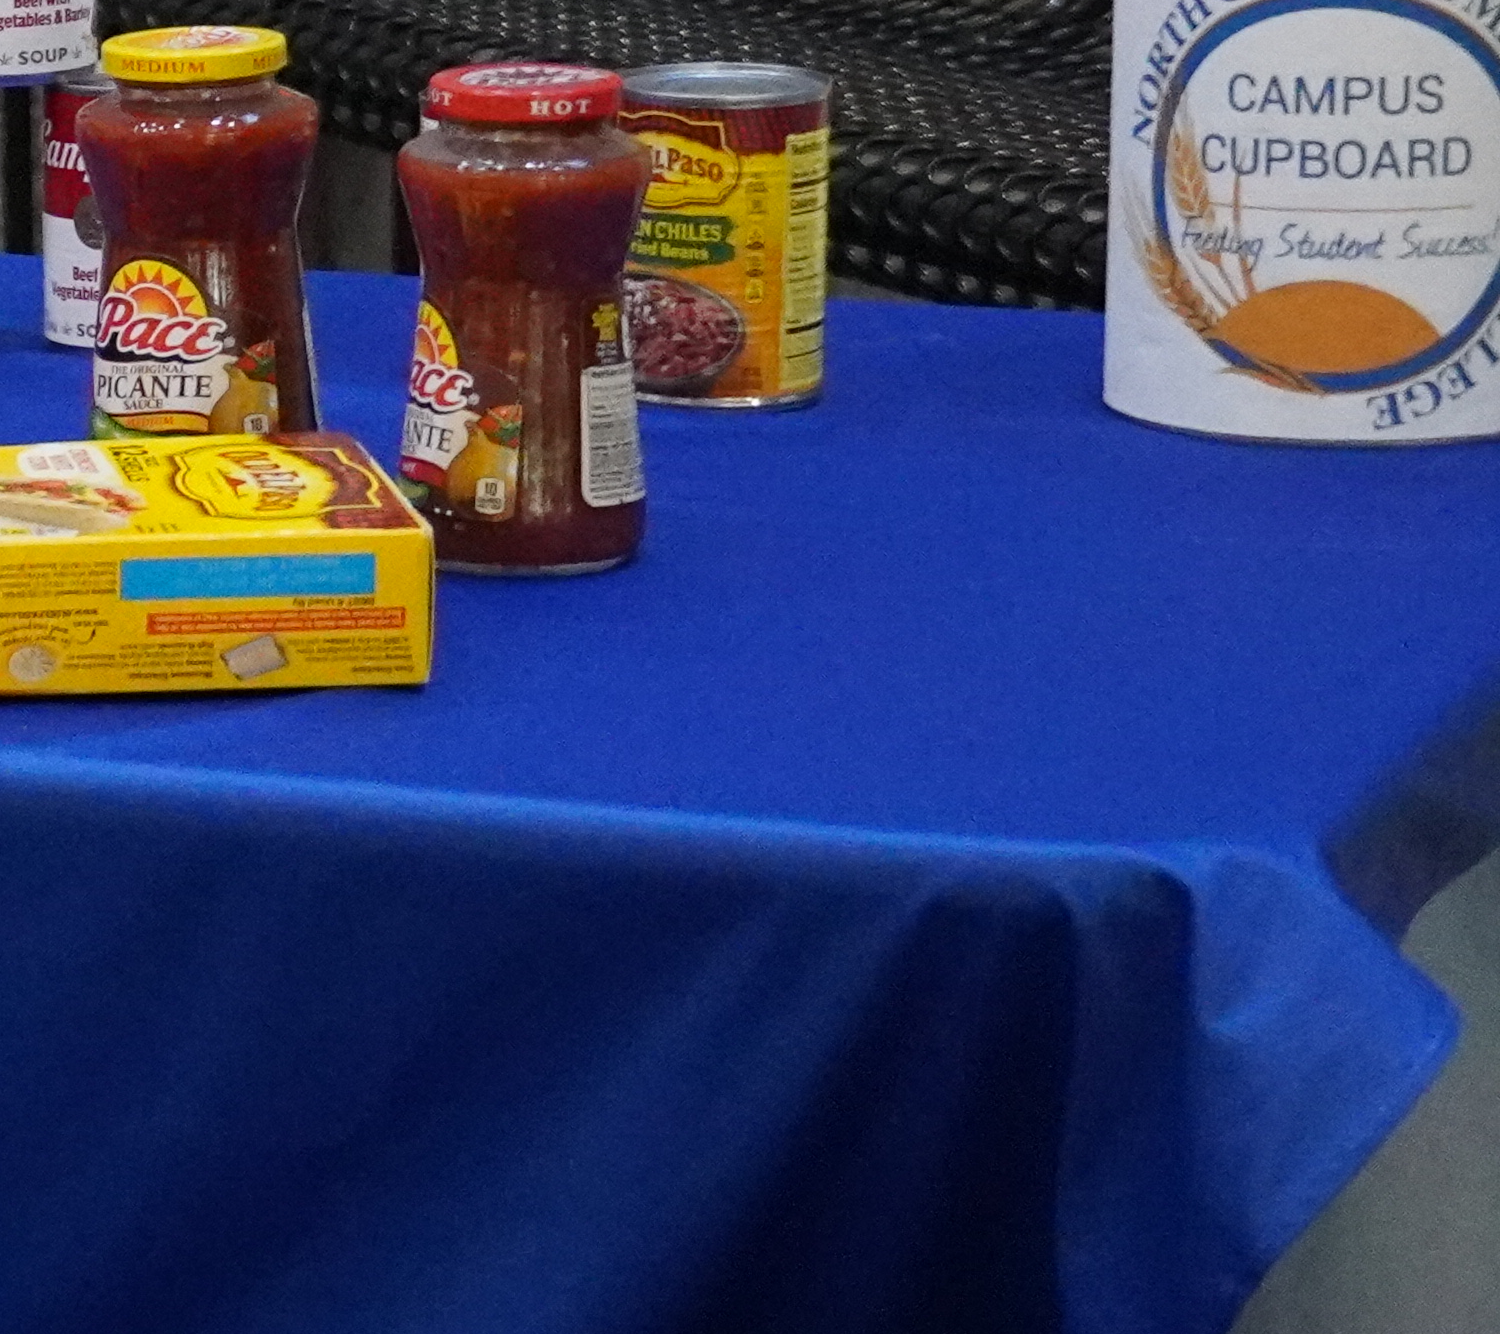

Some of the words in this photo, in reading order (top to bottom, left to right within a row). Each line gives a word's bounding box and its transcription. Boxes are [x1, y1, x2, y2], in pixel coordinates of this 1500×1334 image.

[18, 48, 67, 65] SOUP
[121, 57, 207, 77] MEDIUM
[1228, 73, 1444, 115] CAMPUS
[530, 98, 592, 116] HOT
[1201, 134, 1472, 179] CUPBOARD
[654, 222, 723, 243] CHILES
[1279, 222, 1385, 261] Student
[72, 267, 99, 283] Beef
[98, 293, 227, 359] Pace
[130, 364, 186, 375] ORIGINAL
[97, 374, 213, 399] PICANTE
[124, 399, 164, 410] SAUCE
